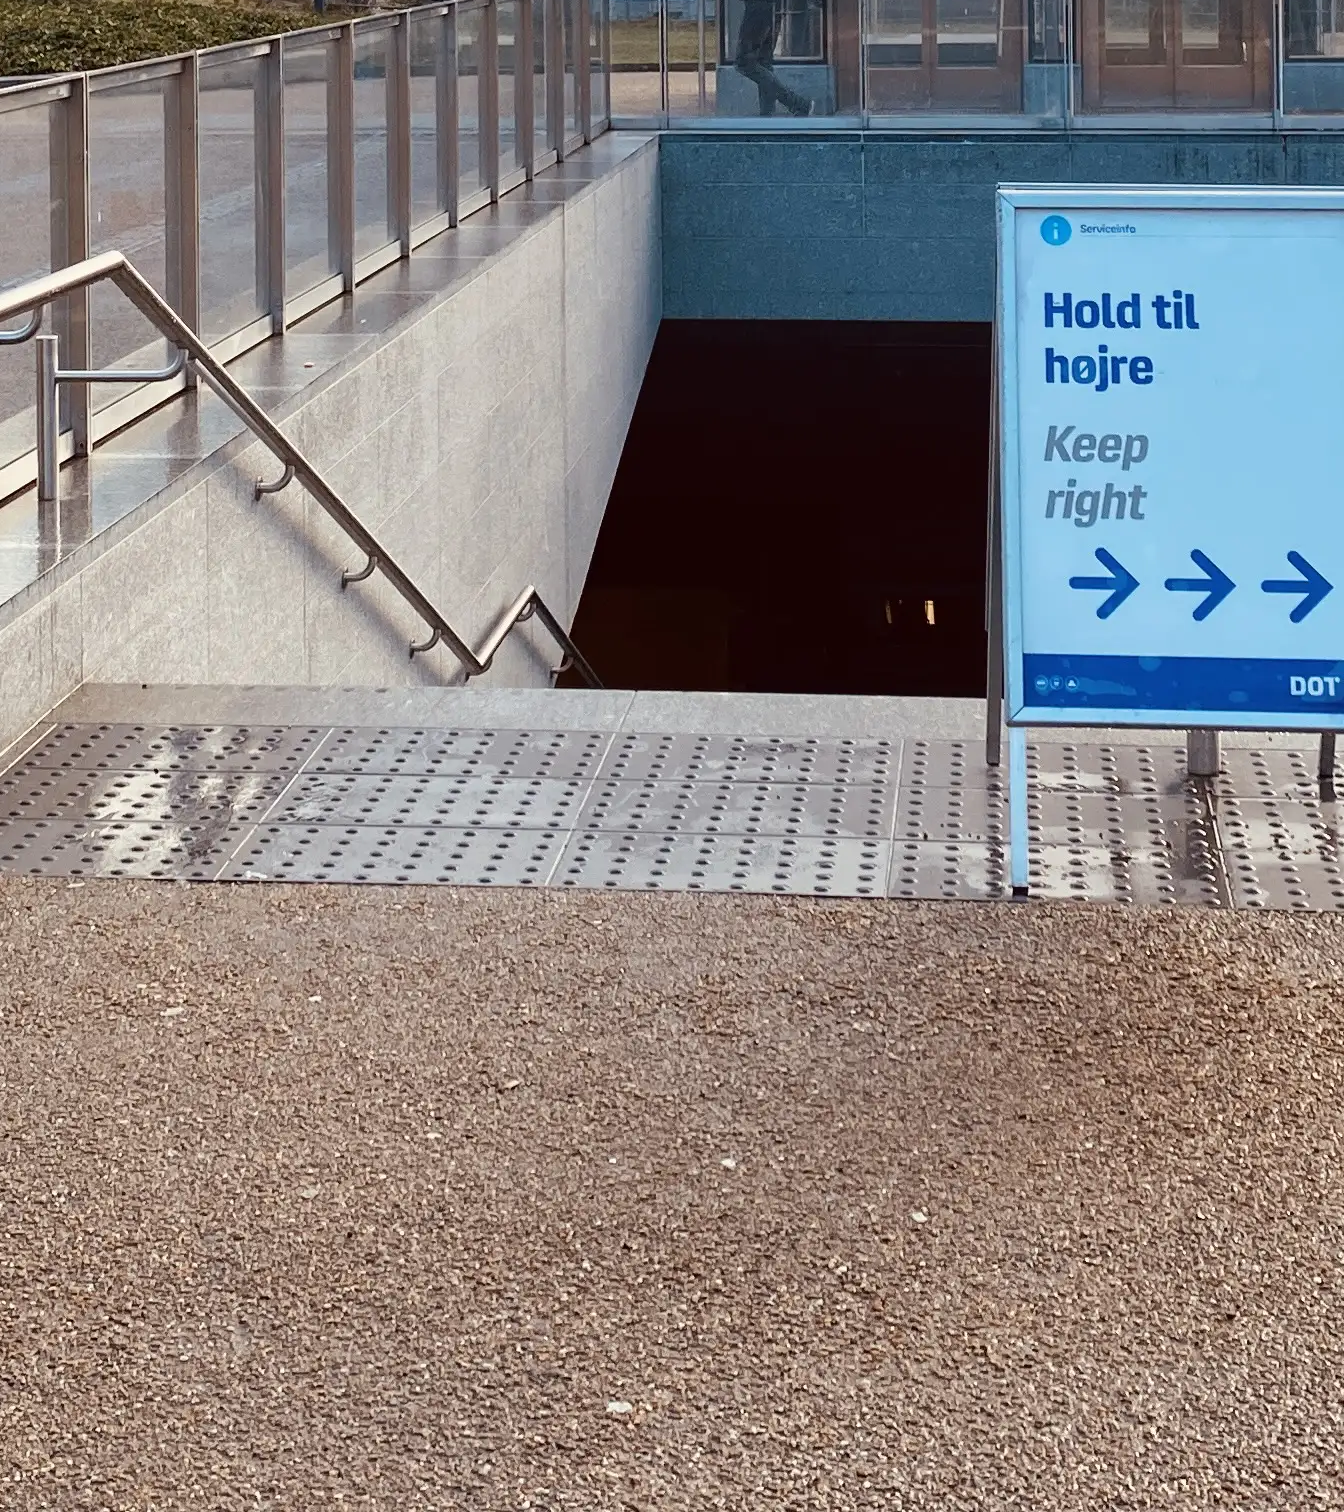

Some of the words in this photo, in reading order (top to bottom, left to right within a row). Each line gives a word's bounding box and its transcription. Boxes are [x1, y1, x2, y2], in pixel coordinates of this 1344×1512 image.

[1080, 224, 1136, 234] Serviceinfo
[1044, 292, 1141, 329] Hold
[1152, 289, 1199, 330] til
[1044, 344, 1154, 392] højre
[1043, 424, 1150, 471] Keep
[1044, 478, 1148, 528] right
[1290, 675, 1341, 697] DOT
